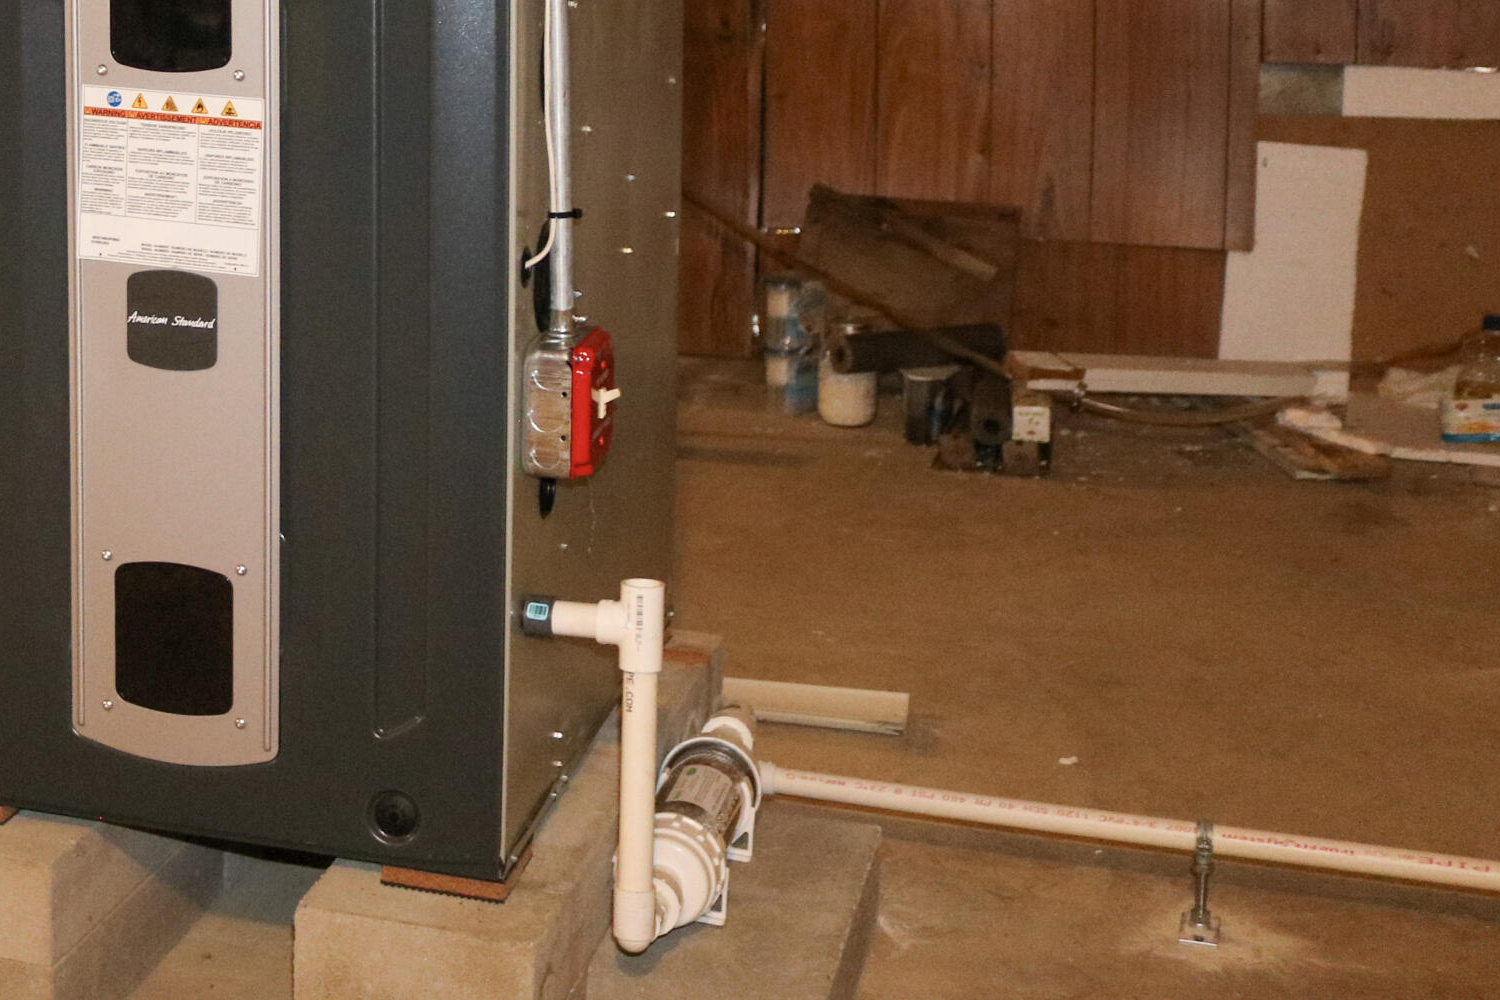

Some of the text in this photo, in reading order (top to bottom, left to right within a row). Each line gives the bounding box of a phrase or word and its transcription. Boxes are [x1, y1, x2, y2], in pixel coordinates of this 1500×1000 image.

[91, 108, 127, 118] WARNING
[136, 111, 198, 124] AVERTISSEMENT
[207, 117, 263, 129] ADVERTENCIA
[127, 310, 216, 329] American Standard
[1418, 856, 1491, 873] PIPE
